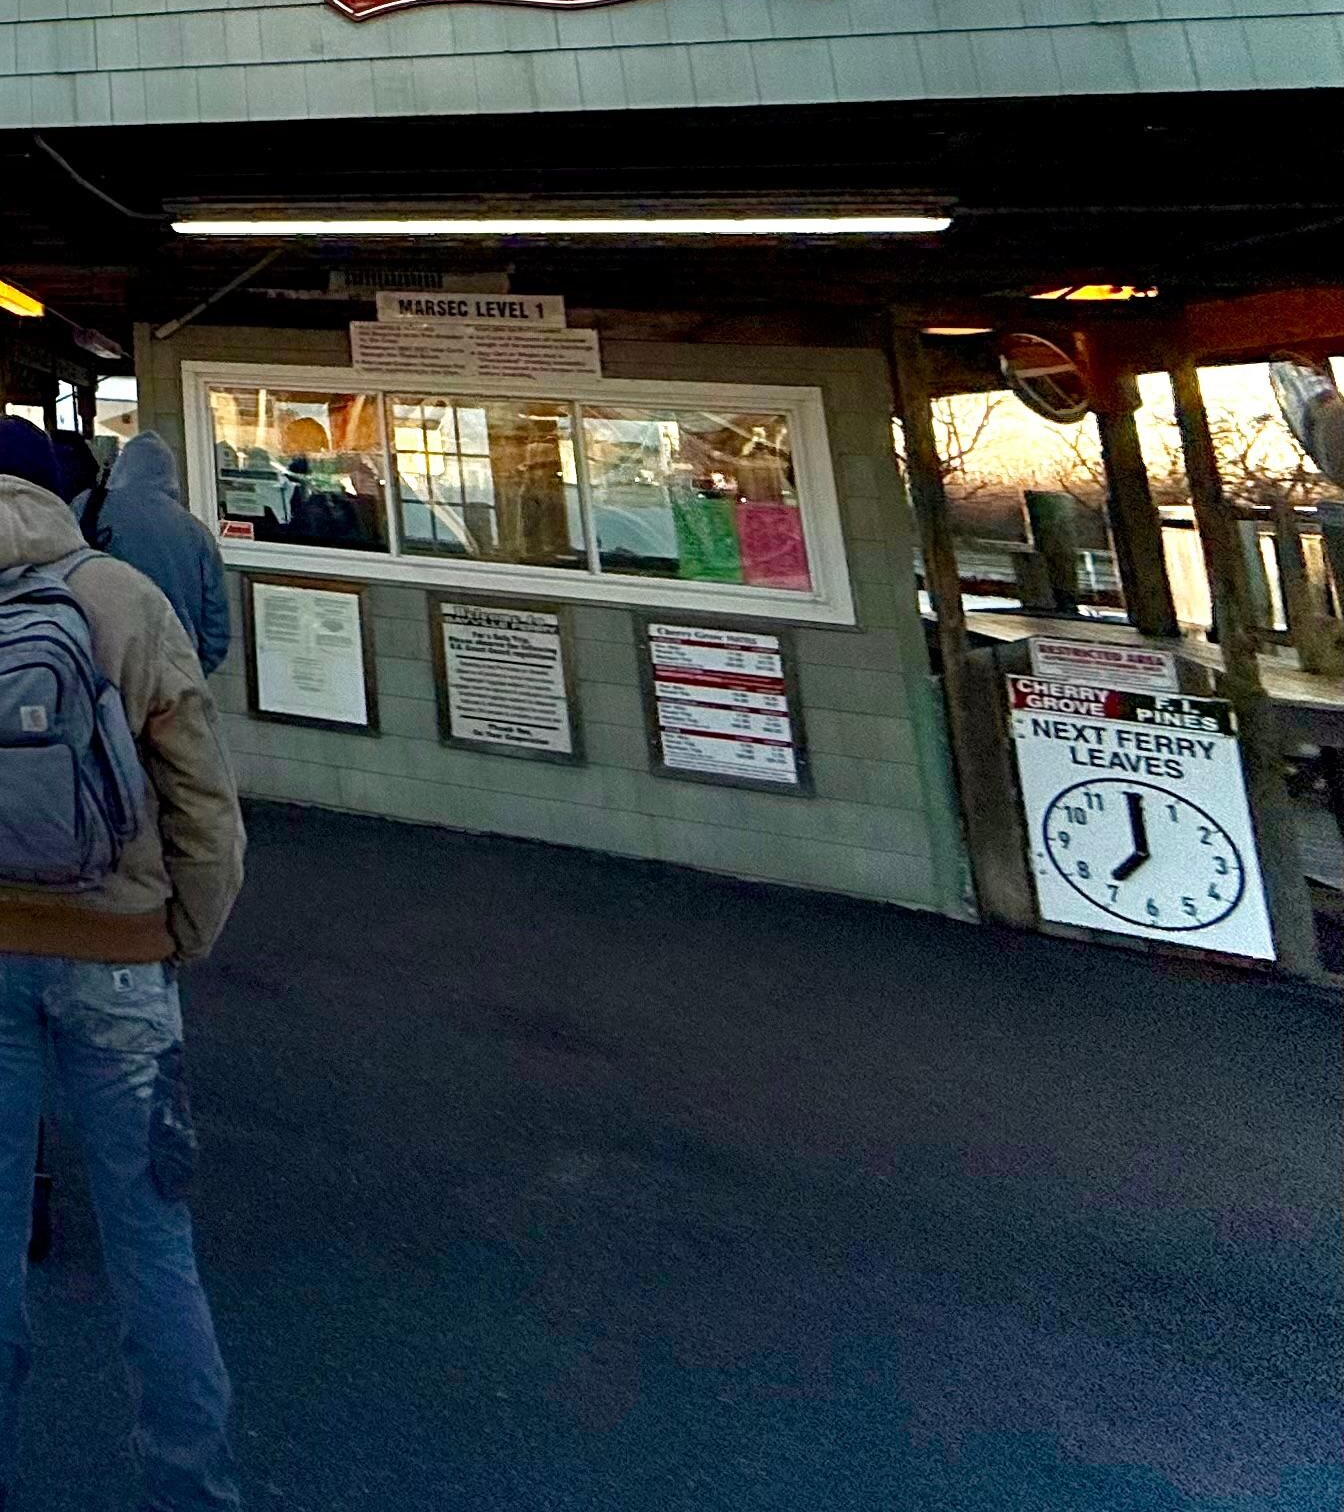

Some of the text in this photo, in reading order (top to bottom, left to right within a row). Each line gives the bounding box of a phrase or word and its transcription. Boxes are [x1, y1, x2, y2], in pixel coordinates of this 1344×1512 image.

[398, 299, 544, 319] MARSEC LEVEL 1
[1015, 679, 1110, 703] CHERRY
[1025, 696, 1106, 717] GROVE
[1135, 707, 1220, 732] PINES
[1031, 718, 1216, 761] NEXT FERRY
[1070, 747, 1184, 780] LEAVES
[1083, 791, 1105, 812] 11
[1063, 805, 1088, 826] 10
[1165, 803, 1179, 823] 1
[1057, 830, 1071, 849] 9
[1197, 825, 1213, 846] 2
[1076, 860, 1091, 880] 8
[1212, 855, 1229, 876] 3
[1105, 883, 1120, 903] 7
[1207, 882, 1222, 901] 4
[1146, 897, 1160, 917] 6
[1181, 895, 1197, 917] 5
